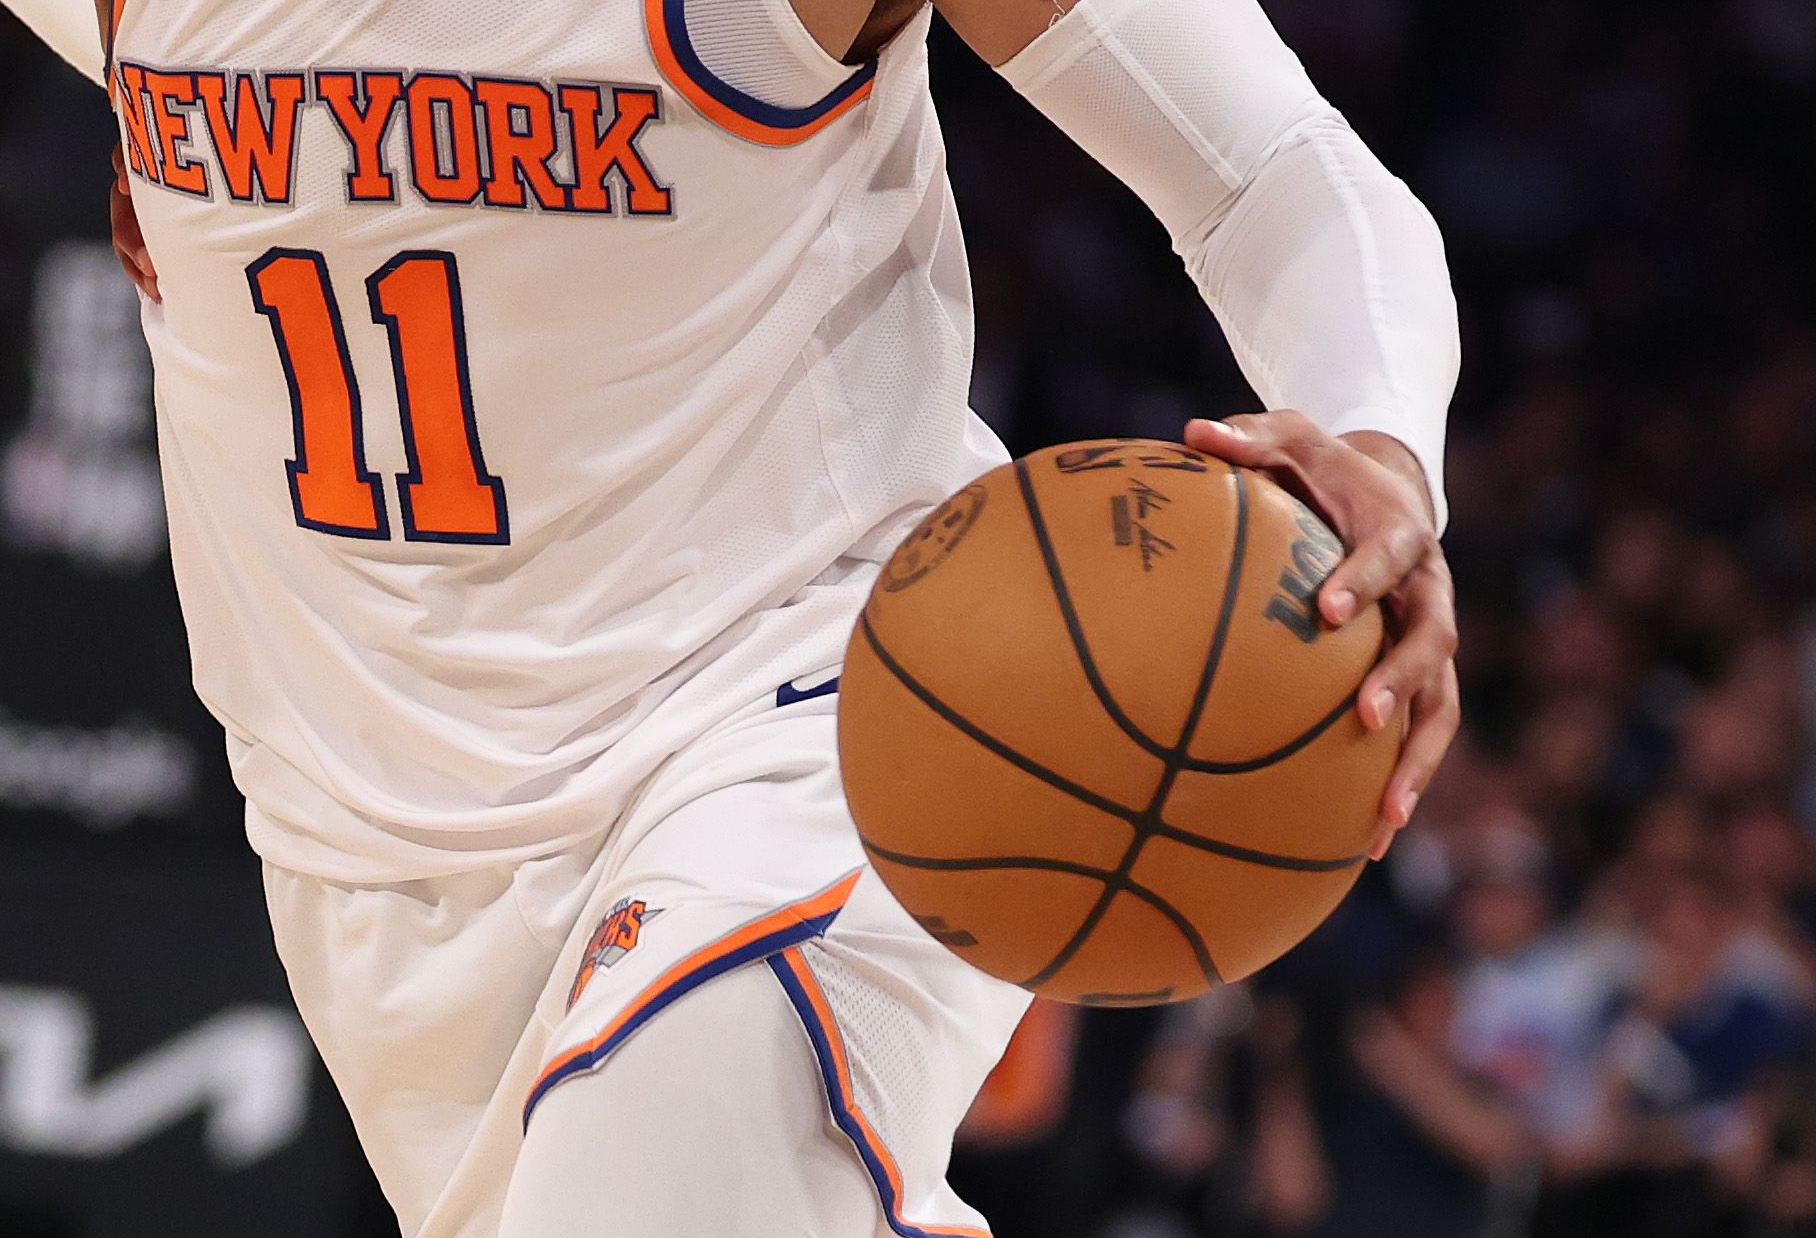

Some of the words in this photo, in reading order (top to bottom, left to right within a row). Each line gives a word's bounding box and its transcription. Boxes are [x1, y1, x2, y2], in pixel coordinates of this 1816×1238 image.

[114, 62, 308, 207] NEW
[311, 66, 678, 219] YORK
[244, 246, 511, 546] 11
